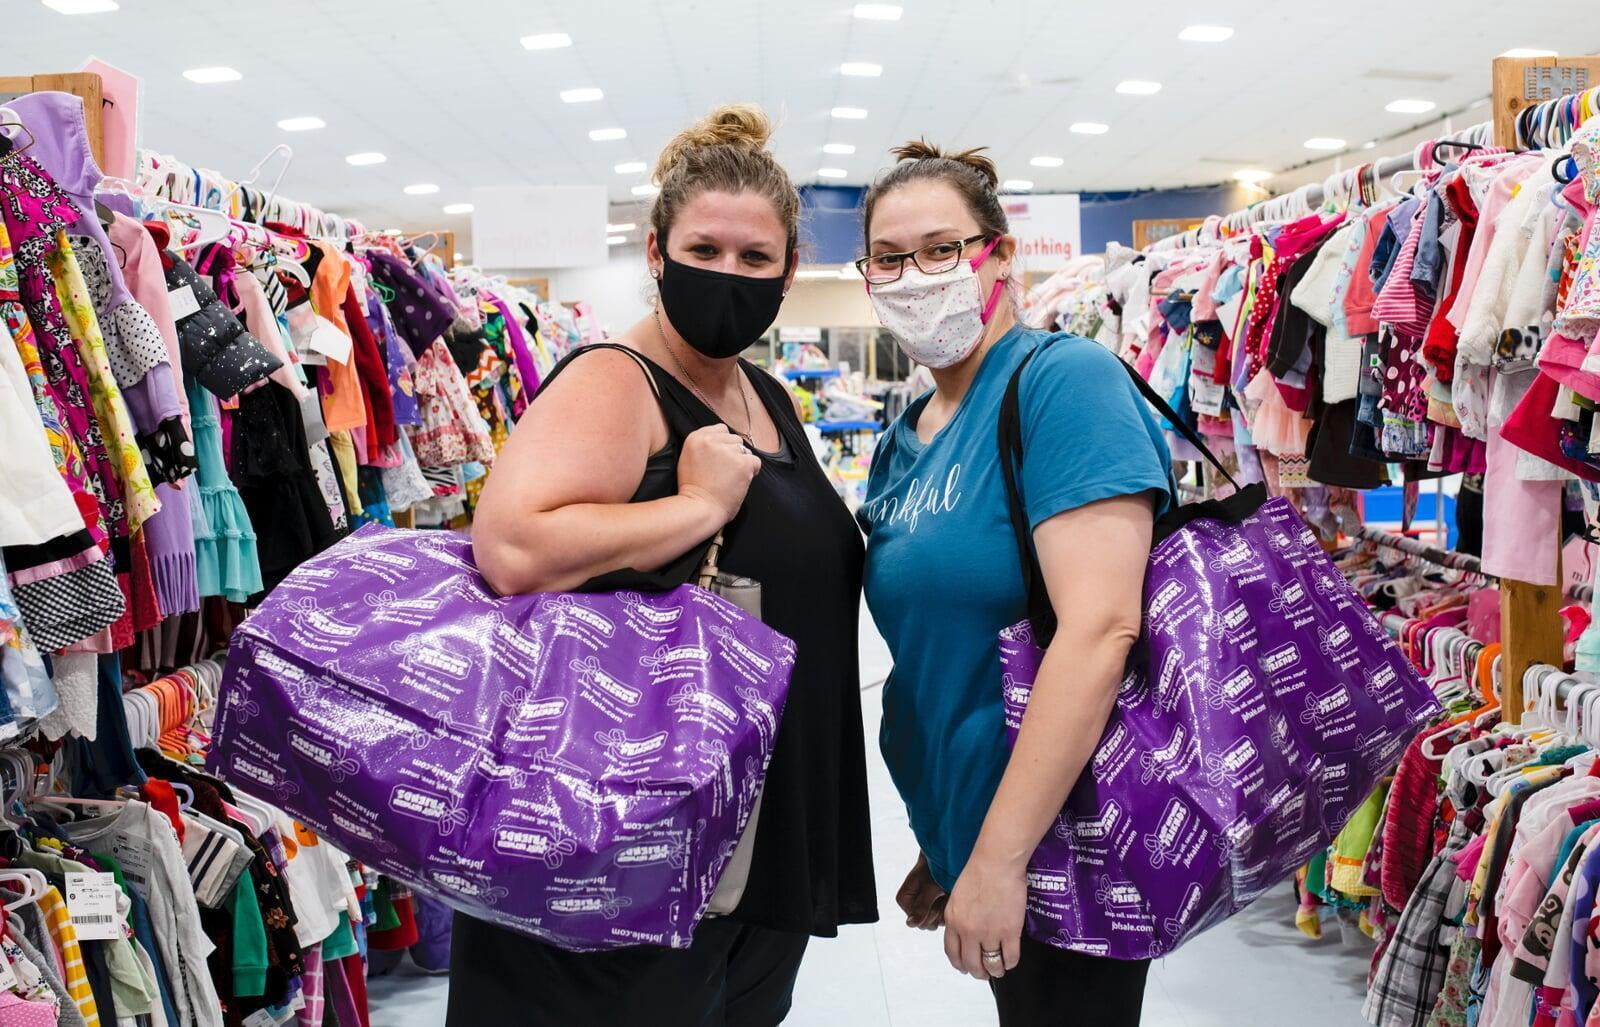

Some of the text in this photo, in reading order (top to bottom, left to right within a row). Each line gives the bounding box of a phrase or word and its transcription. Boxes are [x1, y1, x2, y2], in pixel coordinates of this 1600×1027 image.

[1019, 237, 1071, 260] lothing
[868, 463, 962, 533] ankful
[289, 632, 338, 653] jbfsale.com
[400, 676, 450, 702] jbfsale.com
[580, 691, 623, 724] jbfsale.com
[240, 732, 280, 761] jbfsale.com
[1323, 769, 1346, 781] ENDS
[335, 789, 380, 821] jbfsale.com
[397, 790, 446, 811] FRIENDS
[499, 829, 548, 846] FRIENDS
[1164, 806, 1187, 847] FRIENDS
[1027, 880, 1067, 891] FRIENDS
[611, 927, 664, 944] jbfsale.com
[1112, 921, 1154, 932] jbfsale.com
